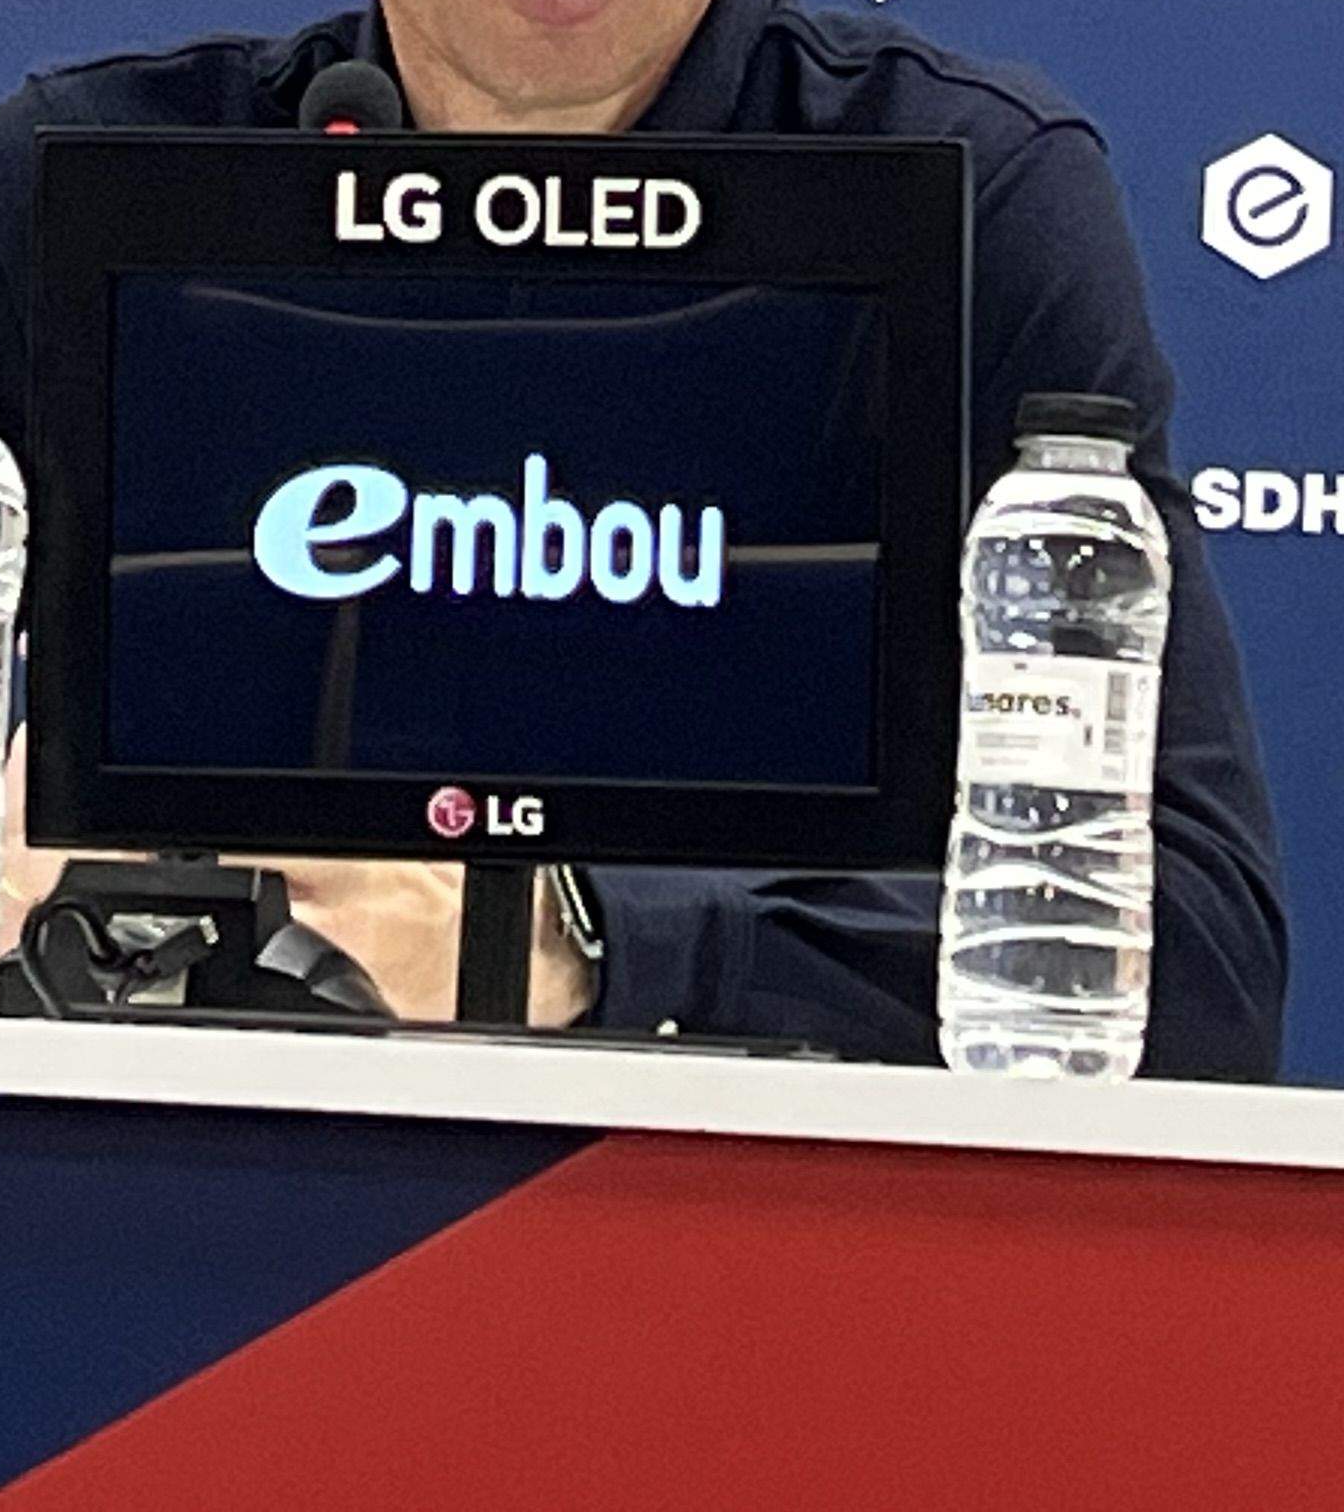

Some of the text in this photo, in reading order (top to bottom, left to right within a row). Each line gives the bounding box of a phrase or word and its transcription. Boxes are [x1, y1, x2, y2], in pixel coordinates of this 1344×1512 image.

[336, 171, 701, 248] LG OLED
[253, 452, 724, 607] embou
[487, 795, 544, 836] LG
